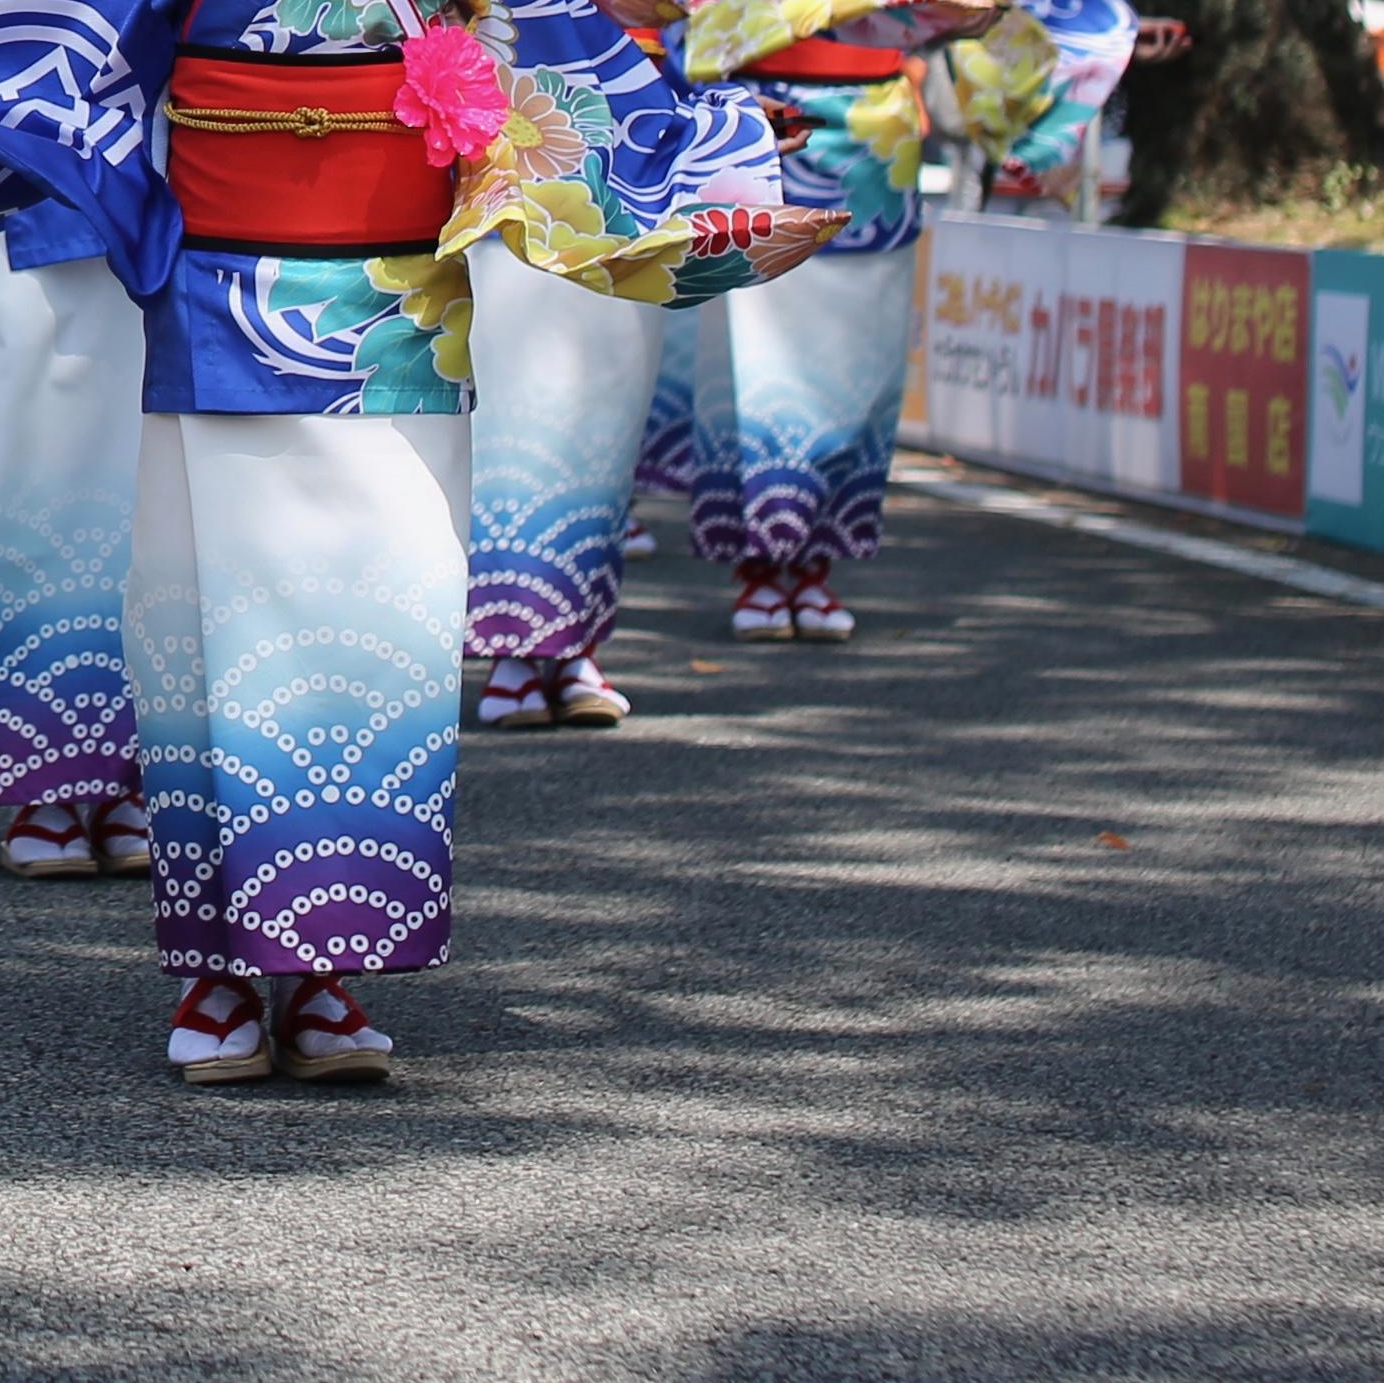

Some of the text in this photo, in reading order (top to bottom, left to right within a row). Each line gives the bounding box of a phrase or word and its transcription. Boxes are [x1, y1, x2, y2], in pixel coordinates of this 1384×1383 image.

[1189, 278, 1298, 363] はりまや店
